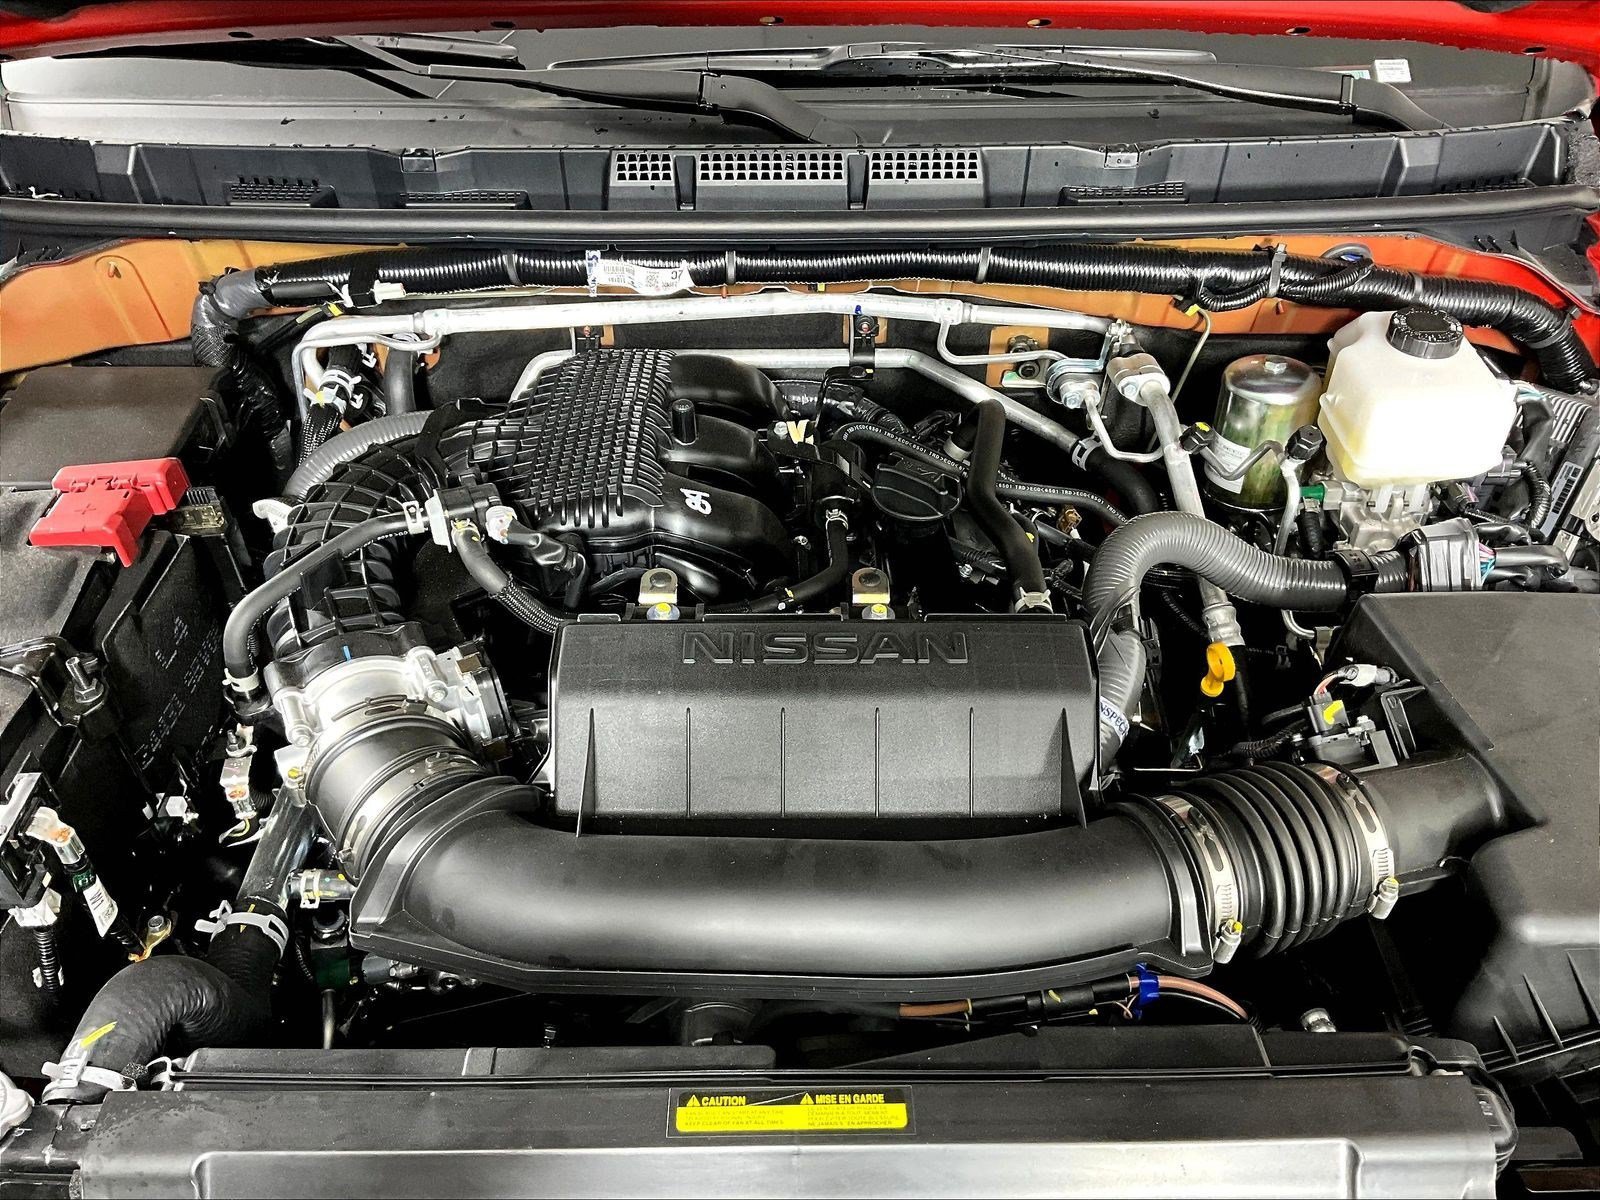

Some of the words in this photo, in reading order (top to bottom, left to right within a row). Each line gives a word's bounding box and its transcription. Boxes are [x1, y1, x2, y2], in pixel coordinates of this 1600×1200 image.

[683, 631, 968, 664] NISSAN
[701, 1096, 746, 1106] CAUTION
[815, 1095, 837, 1104] MISE
[838, 1094, 853, 1104] EN
[854, 1094, 885, 1104] GARDE
